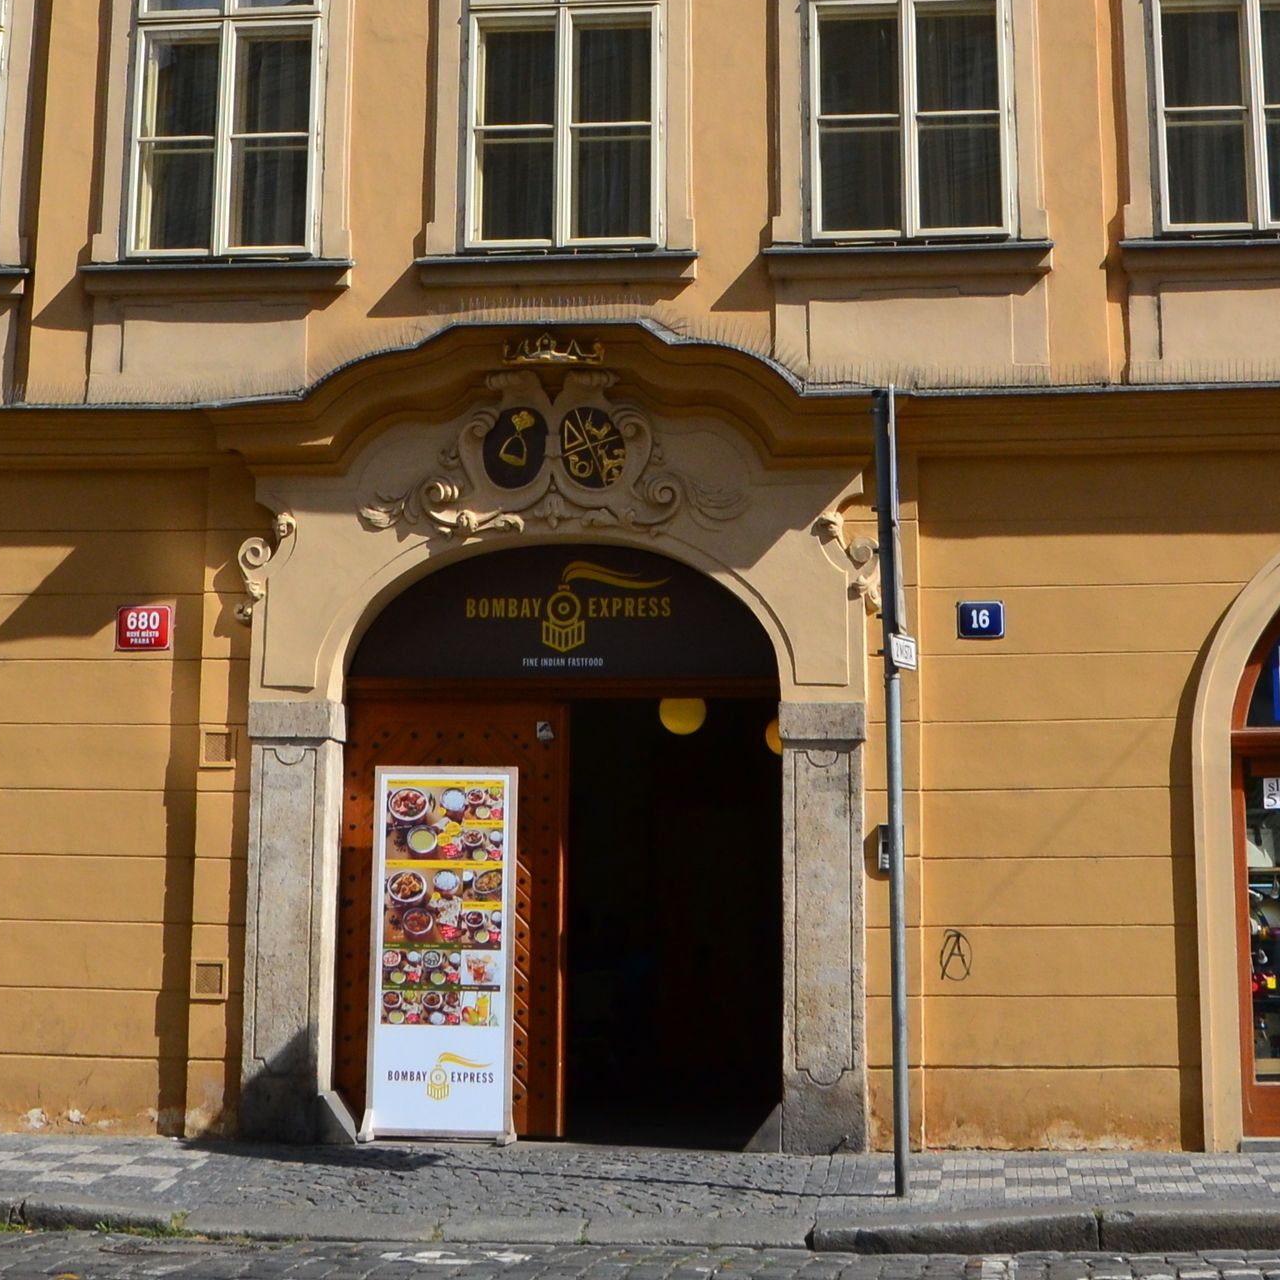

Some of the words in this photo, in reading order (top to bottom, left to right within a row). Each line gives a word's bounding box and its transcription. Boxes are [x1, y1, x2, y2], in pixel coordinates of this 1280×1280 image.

[466, 598, 542, 619] BOMBAY
[588, 597, 672, 618] EXPRESS
[127, 611, 160, 630] 680
[971, 609, 990, 629] 16
[522, 658, 539, 667] FINE
[540, 658, 566, 667] INDIAN
[567, 658, 604, 667] FASTFOOD
[387, 1070, 427, 1081] BOMBAY
[451, 1072, 494, 1083] EXPRESS
